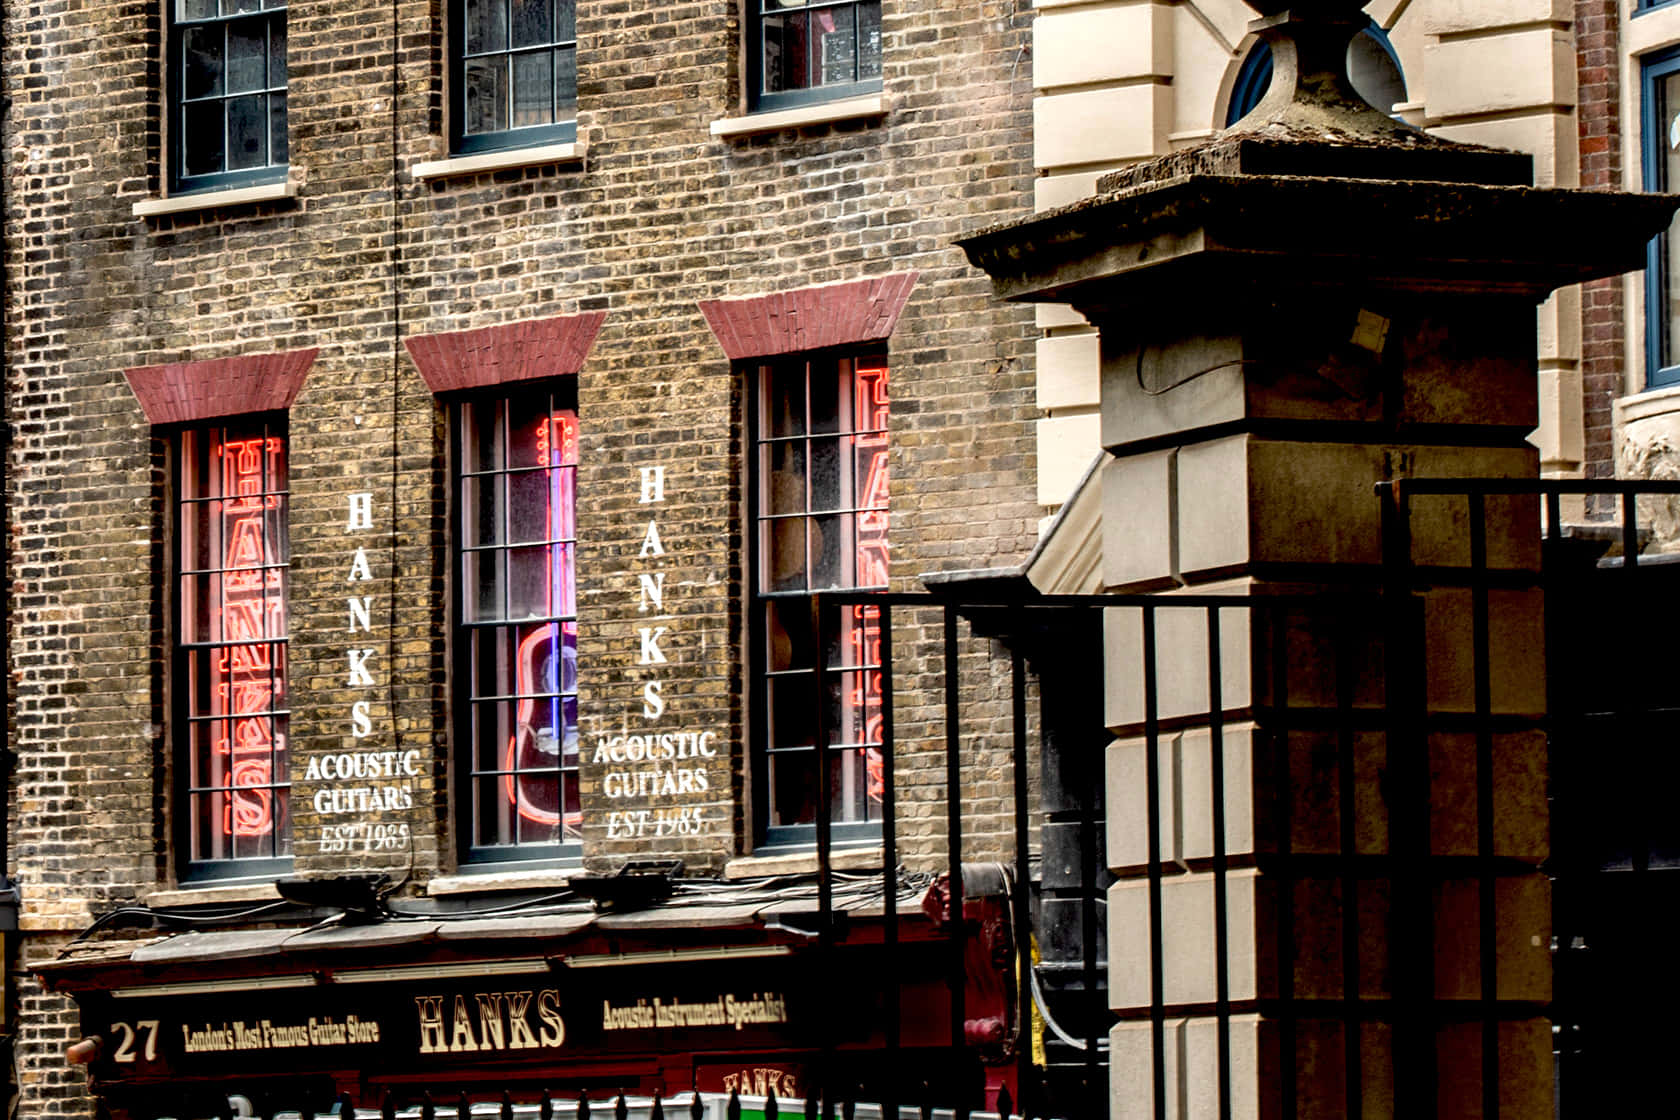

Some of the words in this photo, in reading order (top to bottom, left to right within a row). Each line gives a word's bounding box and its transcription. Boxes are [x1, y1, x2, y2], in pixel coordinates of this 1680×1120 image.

[638, 465, 668, 720] HANKS
[346, 492, 375, 738] HANKS
[218, 436, 288, 836] HANKS
[305, 749, 421, 781] ACOUSTIC
[593, 731, 717, 763] ACOUSTIC
[313, 784, 413, 815] GUITARS
[603, 767, 709, 799] GUITARS
[319, 824, 360, 853] EST
[362, 822, 410, 851] 1985
[606, 810, 652, 840] EST
[654, 806, 702, 837] 1985
[415, 989, 565, 1053] HANKS
[603, 998, 654, 1030] Acoustic
[653, 995, 725, 1028] Instrument
[725, 992, 787, 1031] Specialist
[111, 1020, 160, 1062] 27
[182, 1022, 234, 1052] London's
[232, 1020, 263, 1050] Most
[261, 1019, 309, 1048] Famous
[308, 1016, 346, 1046] Guitar
[346, 1014, 380, 1044] Store
[723, 1068, 795, 1097] HANKS
